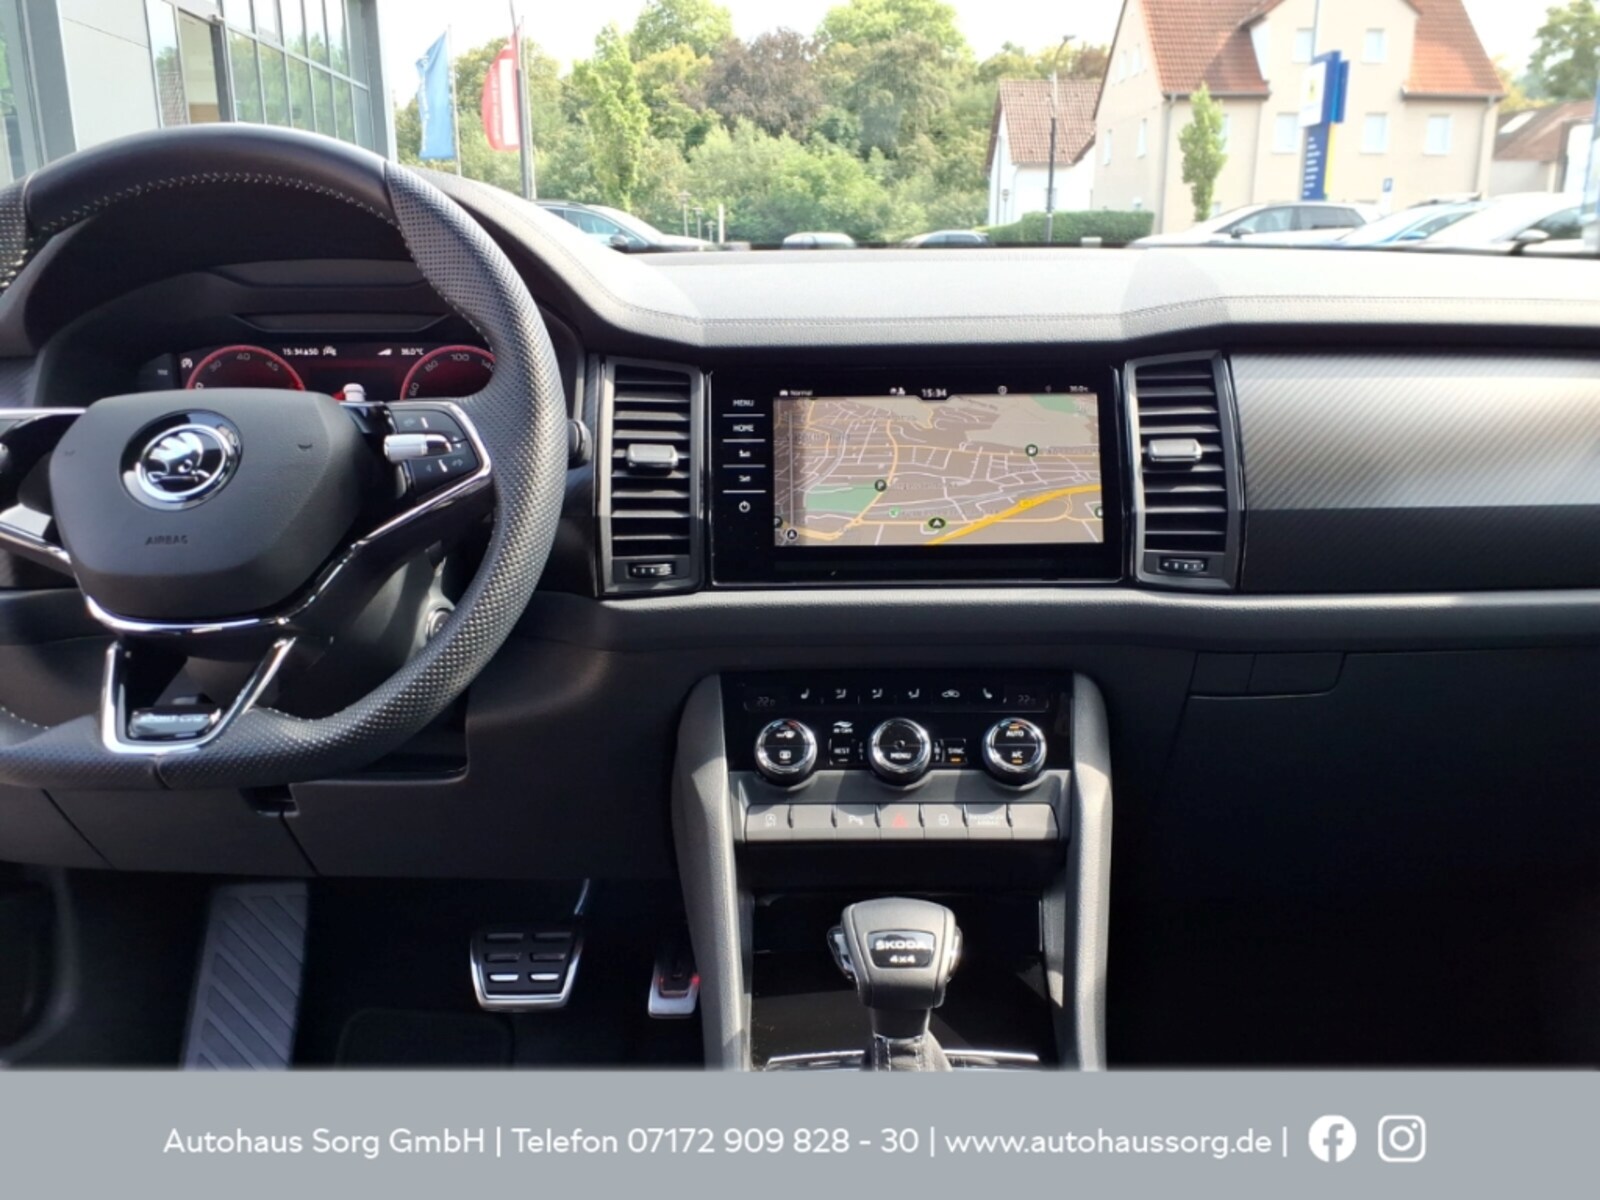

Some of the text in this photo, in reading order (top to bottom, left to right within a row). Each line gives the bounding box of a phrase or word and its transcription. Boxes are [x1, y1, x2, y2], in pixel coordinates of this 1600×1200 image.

[236, 352, 251, 361] 40
[450, 353, 470, 361] 100
[921, 388, 947, 397] 15:34
[732, 399, 754, 407] MENU
[732, 424, 754, 432] HOME
[144, 534, 189, 546] AIRBAG
[890, 751, 911, 760] MENU
